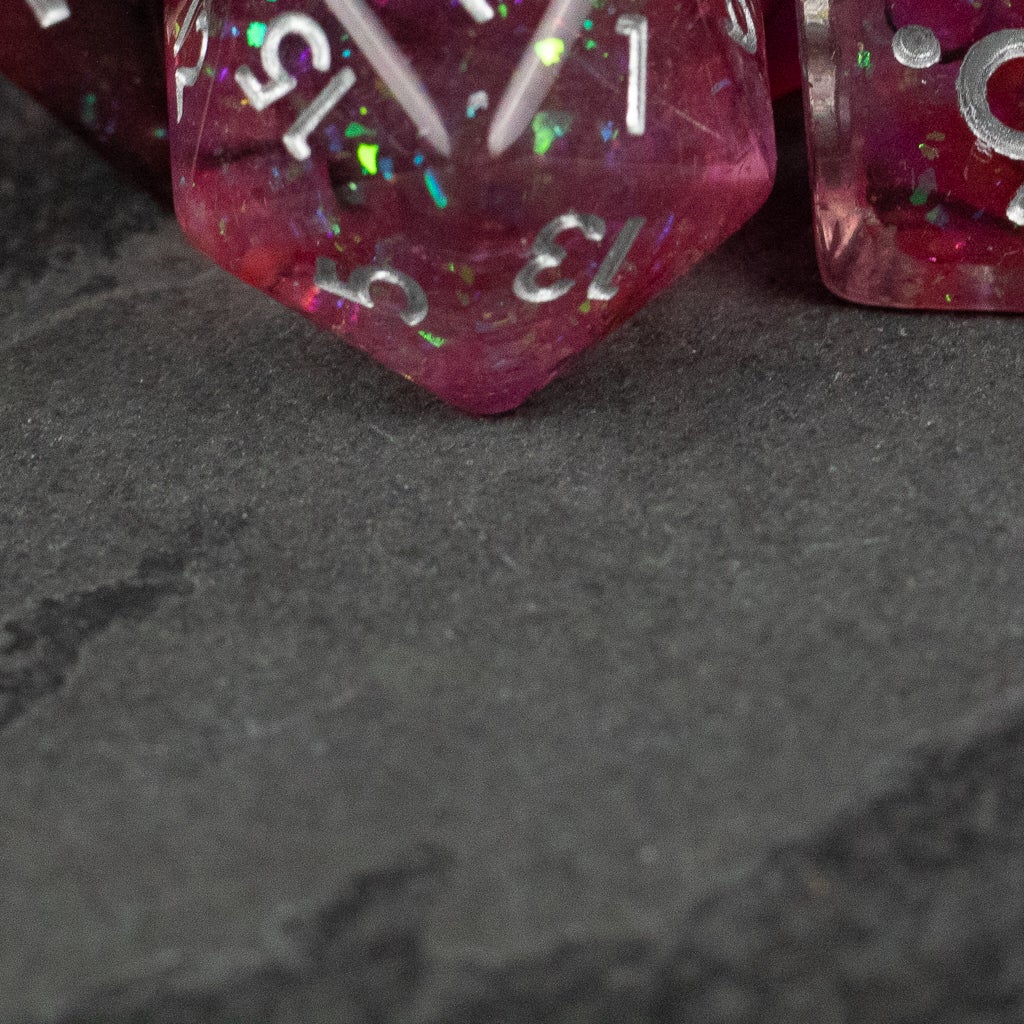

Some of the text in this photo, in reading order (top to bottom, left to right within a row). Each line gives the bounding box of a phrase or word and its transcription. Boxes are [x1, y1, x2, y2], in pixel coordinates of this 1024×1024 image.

[235, 12, 357, 161] 15
[615, 13, 649, 135] 1
[313, 254, 429, 327] 5
[512, 210, 647, 304] 13
